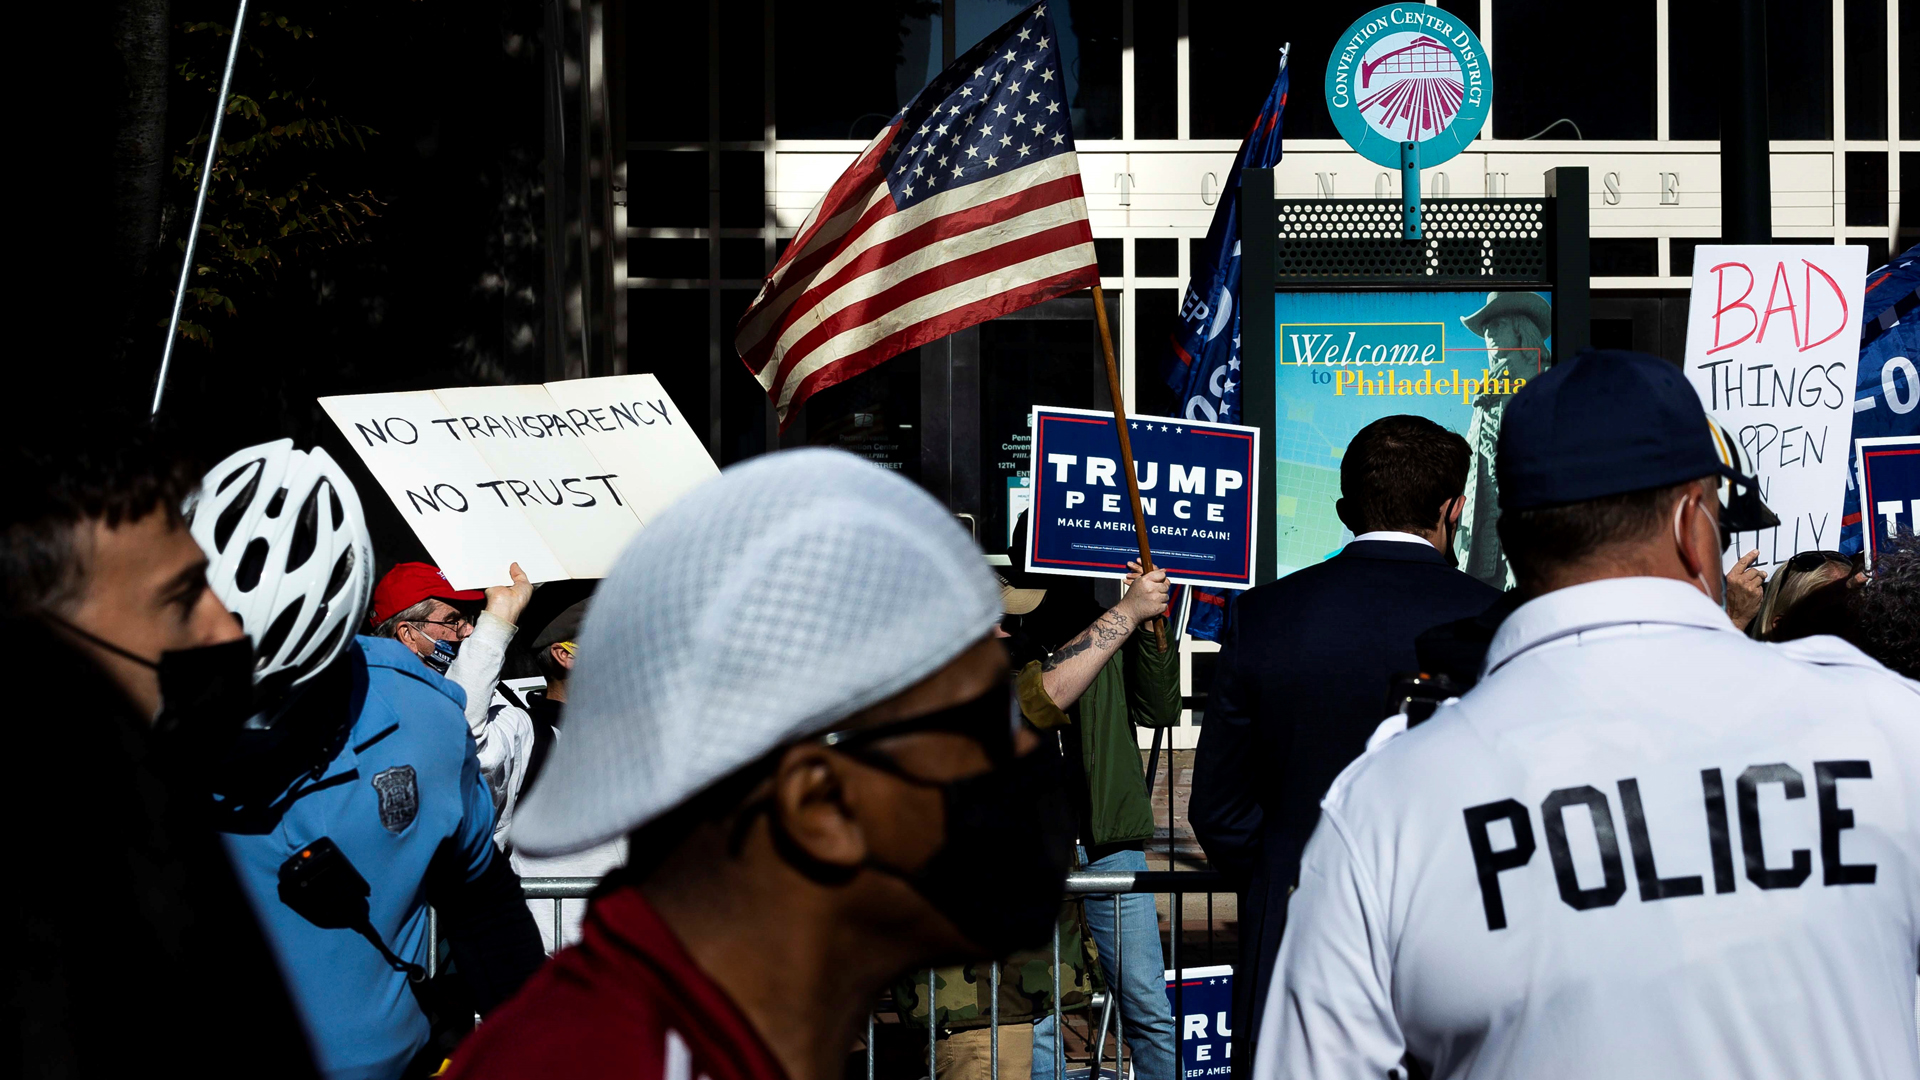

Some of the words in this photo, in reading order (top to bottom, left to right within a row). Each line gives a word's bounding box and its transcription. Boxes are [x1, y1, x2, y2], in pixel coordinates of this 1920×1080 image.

[1332, 16, 1388, 109] CONVENTION
[1390, 8, 1453, 37] CENTER
[1452, 30, 1482, 108] DISTRICT
[1705, 258, 1849, 356] BAD
[1288, 331, 1436, 367] Welcome
[1311, 368, 1332, 385] to
[1333, 369, 1528, 406] Philadelphia
[1697, 358, 1846, 411] THINGS
[354, 416, 418, 447] NO
[431, 399, 673, 441] TRANSPARENCY
[873, 443, 899, 451] Center
[997, 461, 1016, 469] 12TH
[1001, 442, 1031, 451] Conven
[405, 482, 469, 515] NO
[476, 473, 624, 508] TRUST
[1047, 452, 1244, 498] TRUMP
[1065, 490, 1225, 523] PENCE
[1057, 517, 1091, 529] MAKE
[1094, 520, 1148, 533] AMERIC
[1151, 525, 1188, 537] GREAT
[1191, 529, 1231, 541] AGAIN!
[1462, 759, 1878, 932] POLICE
